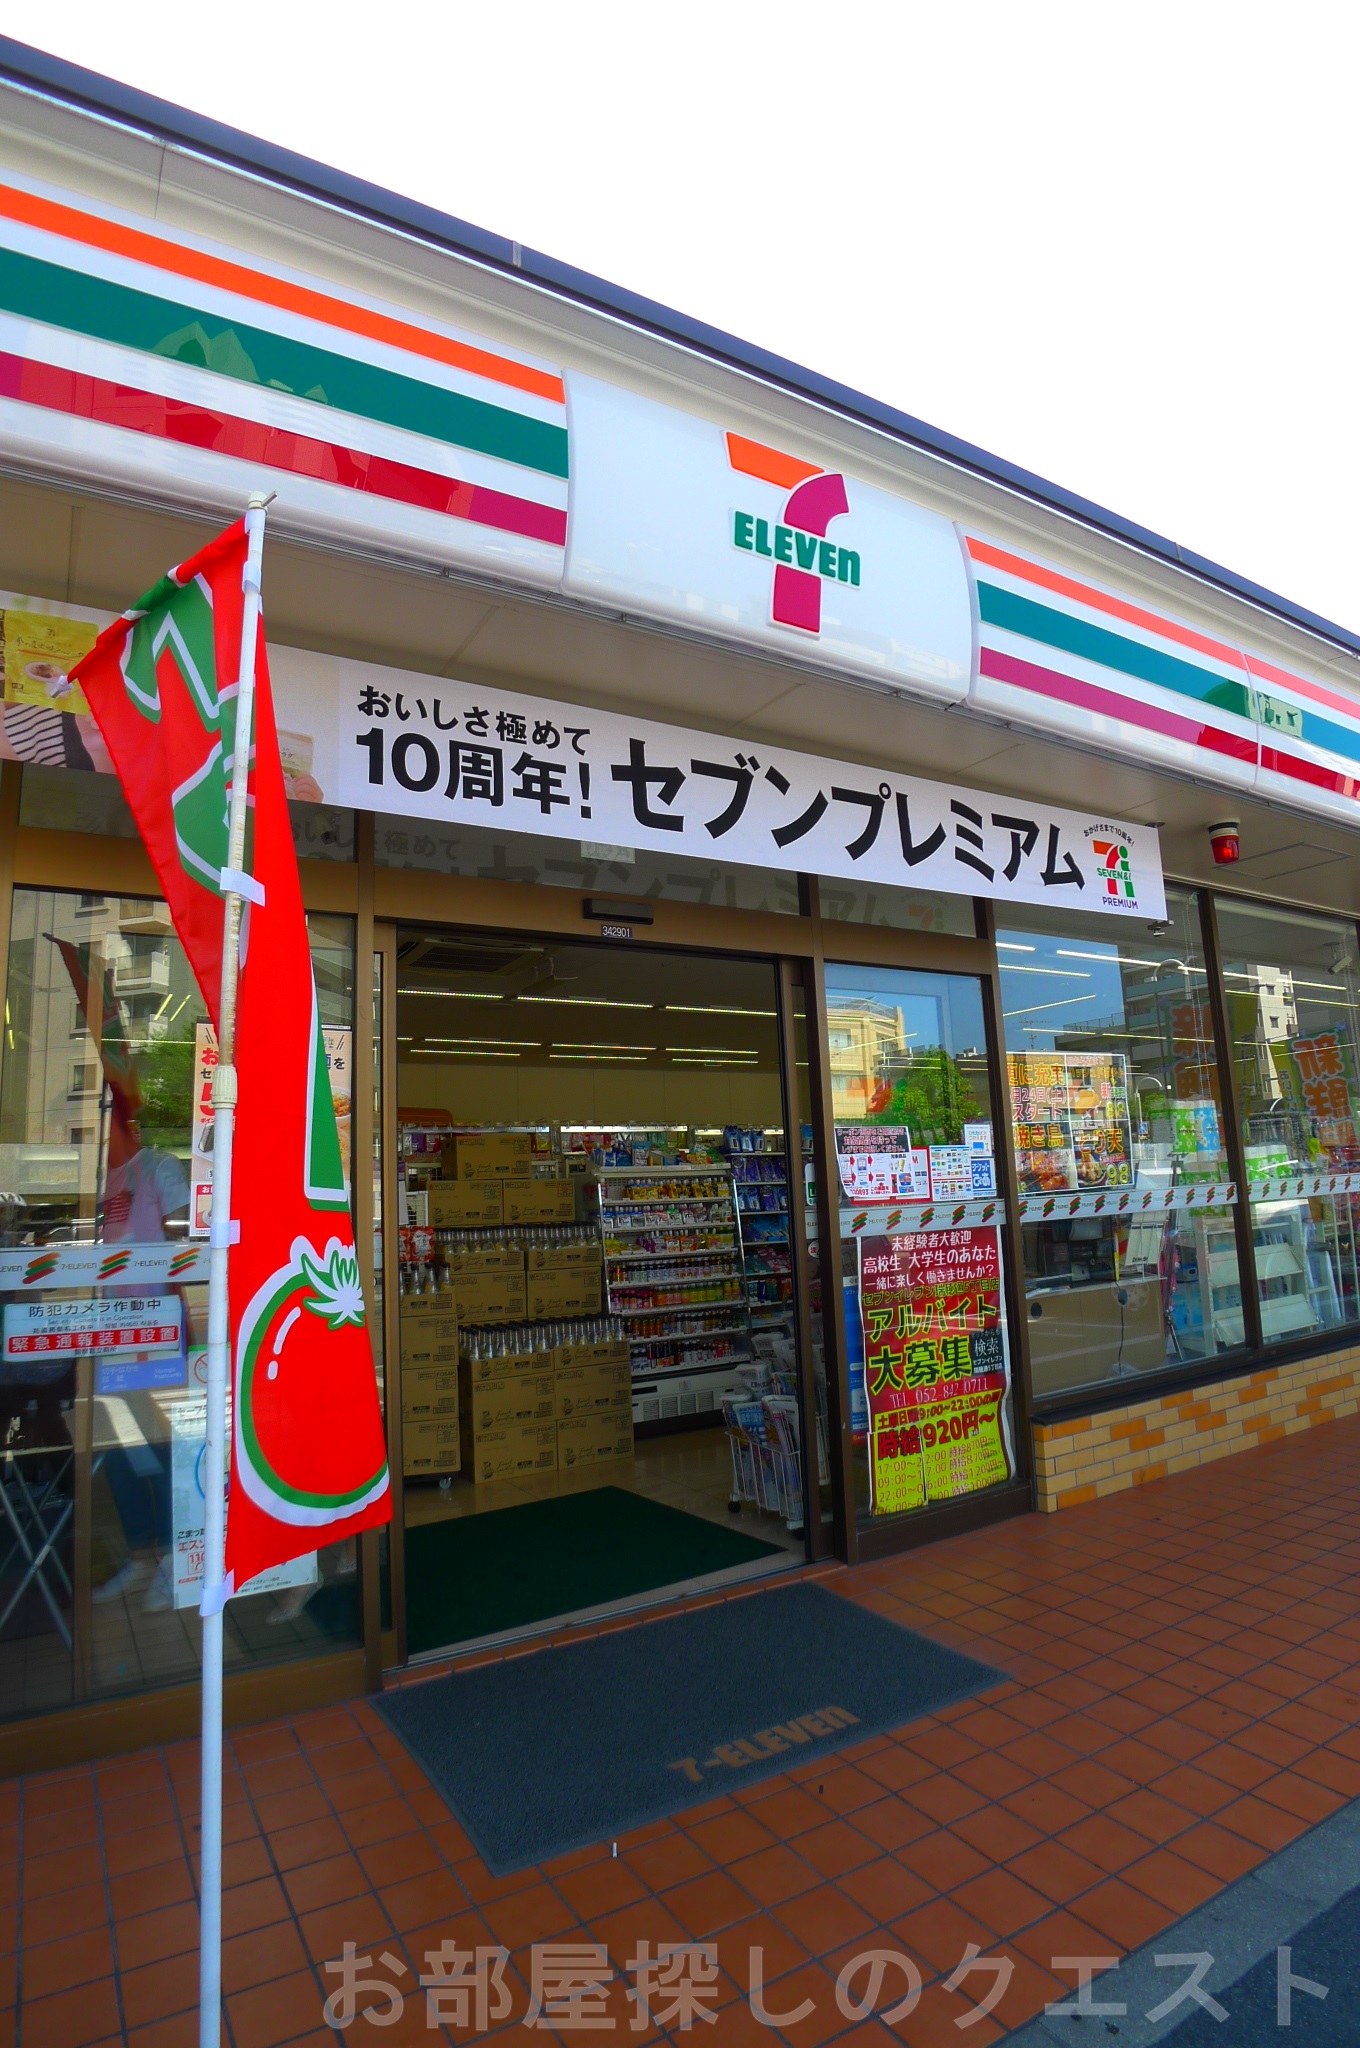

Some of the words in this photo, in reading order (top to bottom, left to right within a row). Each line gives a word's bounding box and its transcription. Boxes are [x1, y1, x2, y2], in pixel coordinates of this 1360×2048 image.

[356, 684, 592, 757] おいしさ極めて
[355, 727, 593, 819] 10周年!
[610, 736, 1086, 891] セブンプレミアム
[1102, 896, 1139, 910] PREMIUM
[602, 925, 631, 938] 342901
[1012, 1103, 1063, 1121] スタート
[1013, 1124, 1065, 1150] 焼き鳥
[1077, 1129, 1124, 1154] とり天
[1106, 1162, 1130, 1186] 98
[891, 1230, 972, 1251] 未経験者大歓迎
[863, 1254, 902, 1275] 高校生
[908, 1245, 997, 1270] 大学生のあなた
[865, 1264, 995, 1290] 一緒に楽しく働きませんか?
[29, 1298, 162, 1317] 防犯カメラ作動中
[867, 1294, 997, 1343] アルバイト
[12, 1327, 176, 1352] 緊急通報装置設置
[974, 1337, 999, 1357] 検索
[868, 1334, 973, 1396] 大募集
[915, 1378, 988, 1404] 052-842-0711
